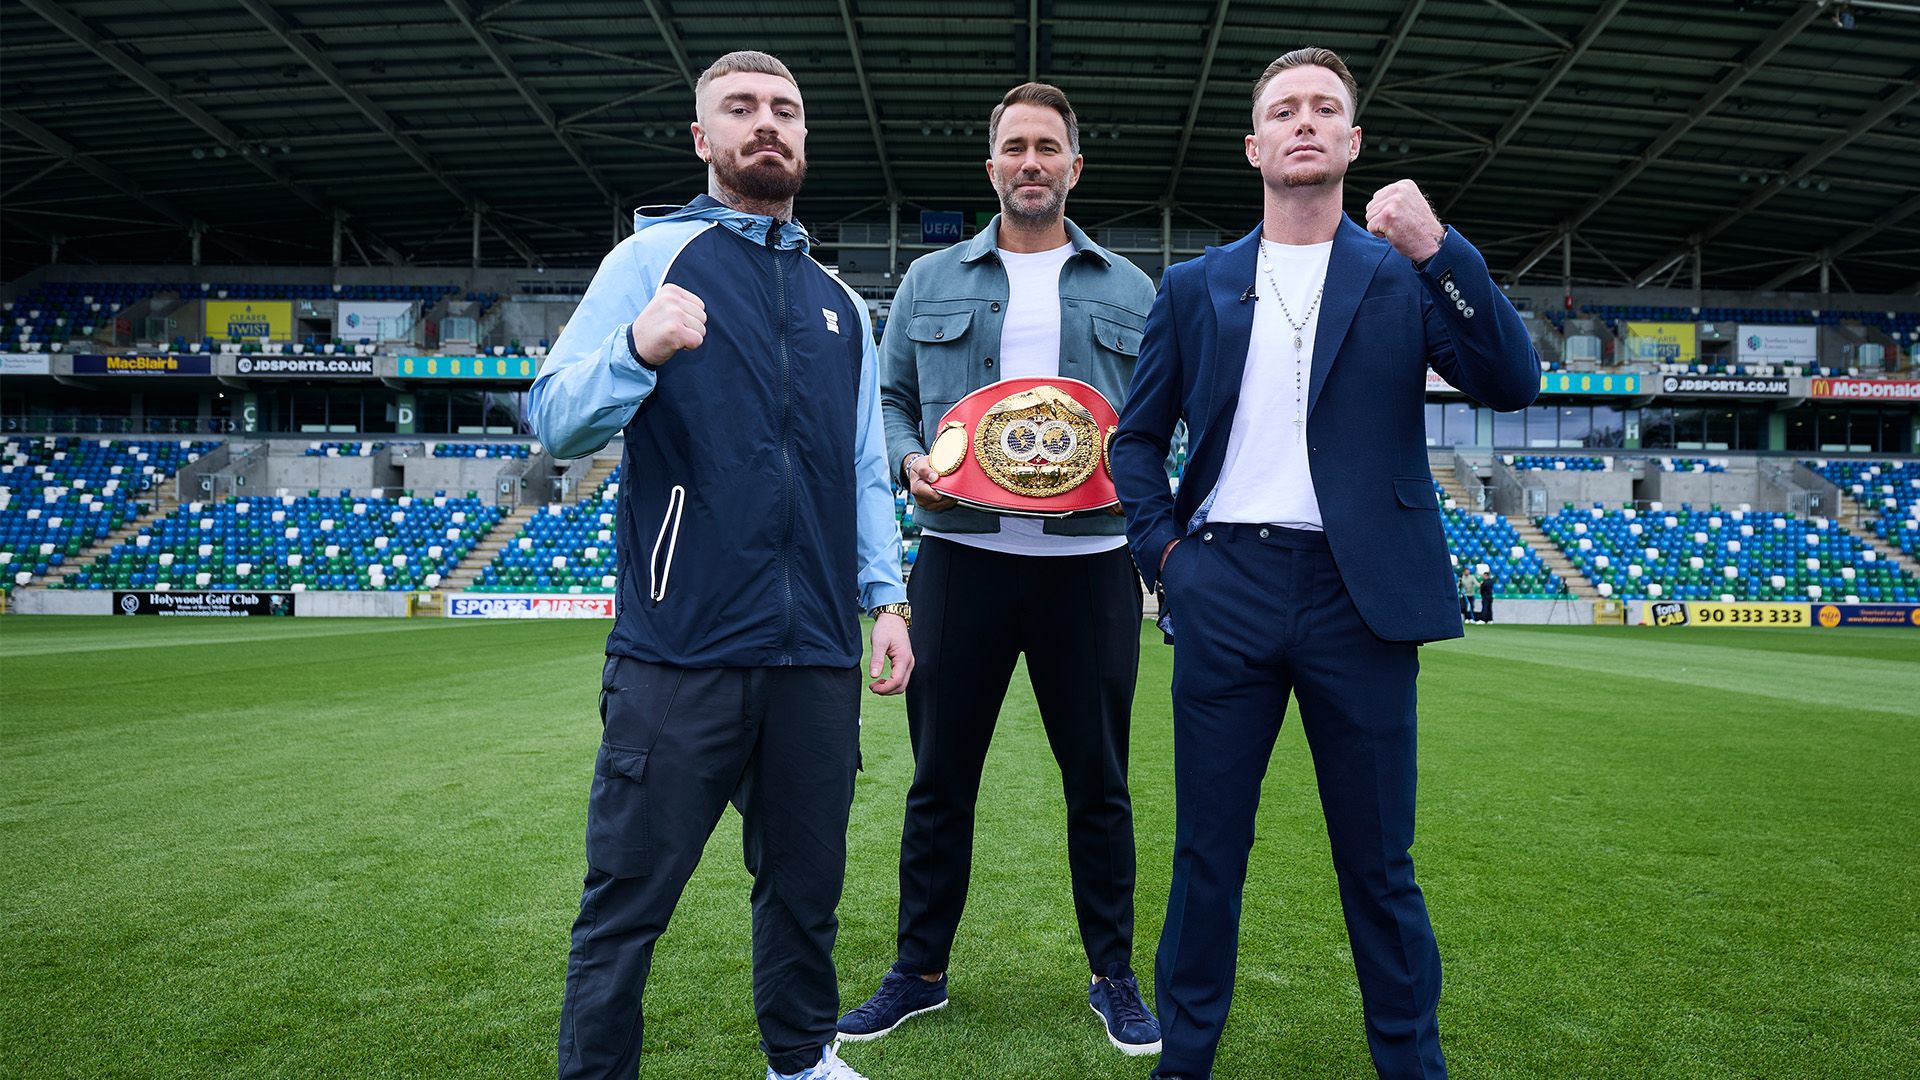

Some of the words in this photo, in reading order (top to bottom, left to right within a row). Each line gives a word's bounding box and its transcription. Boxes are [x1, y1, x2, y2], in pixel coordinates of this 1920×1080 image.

[924, 223, 958, 235] UEFA
[230, 323, 267, 335] TWIST
[107, 356, 167, 369] MacBlair
[253, 360, 372, 372] JDSPORTS.CO.UK
[1679, 380, 1787, 393] JDSPORTS.CO.UK
[399, 408, 413, 424] D
[1626, 424, 1639, 439] H
[150, 594, 203, 606] Holywood
[205, 593, 230, 605] Golf
[232, 593, 259, 605] Club
[455, 600, 528, 615] SPORTS
[536, 600, 608, 615] DIRECT
[1656, 604, 1681, 615] fona
[1657, 612, 1685, 626] CAB
[1699, 609, 1724, 622] 90
[1731, 609, 1763, 623] 333
[1769, 609, 1802, 623] 333
